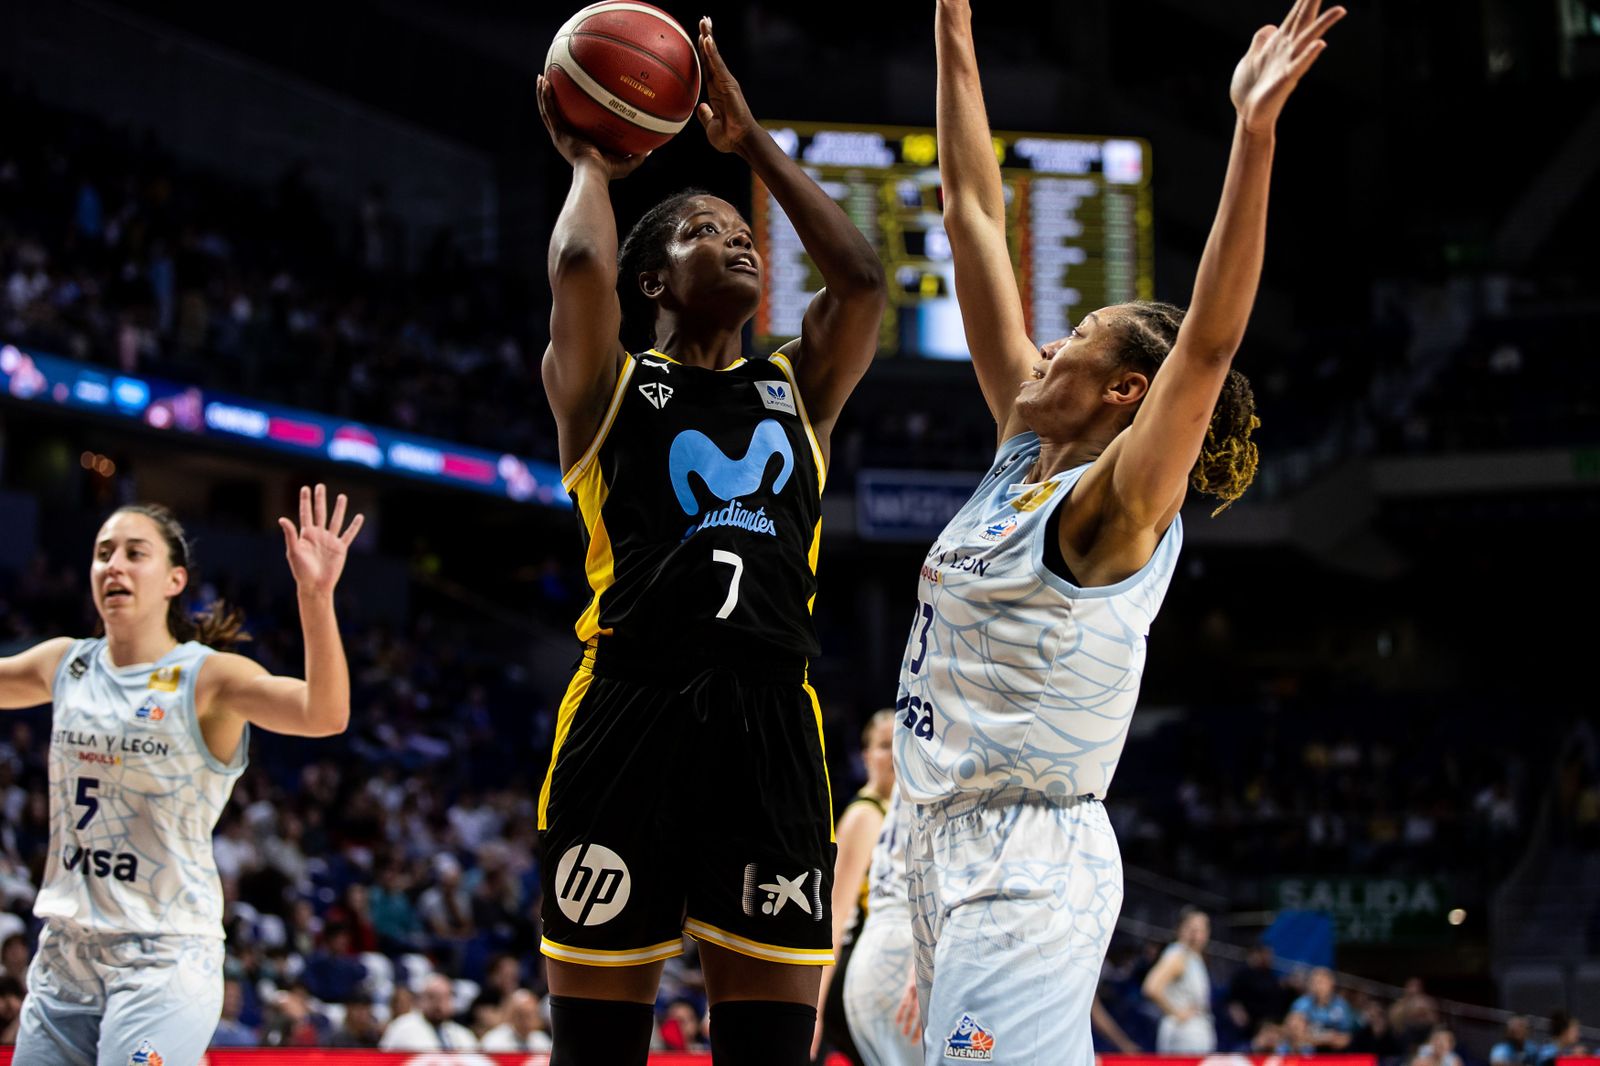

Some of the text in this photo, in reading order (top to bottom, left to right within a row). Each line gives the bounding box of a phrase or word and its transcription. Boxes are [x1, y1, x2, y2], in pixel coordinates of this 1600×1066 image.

[681, 499, 777, 544] udiantes
[713, 549, 744, 619] 7
[105, 735, 116, 752] Y
[121, 736, 169, 756] LEÓN
[75, 776, 99, 830] 5
[560, 844, 624, 925] hp
[1279, 879, 1440, 913] SALIDA
[945, 1047, 991, 1059] AVENIDA
